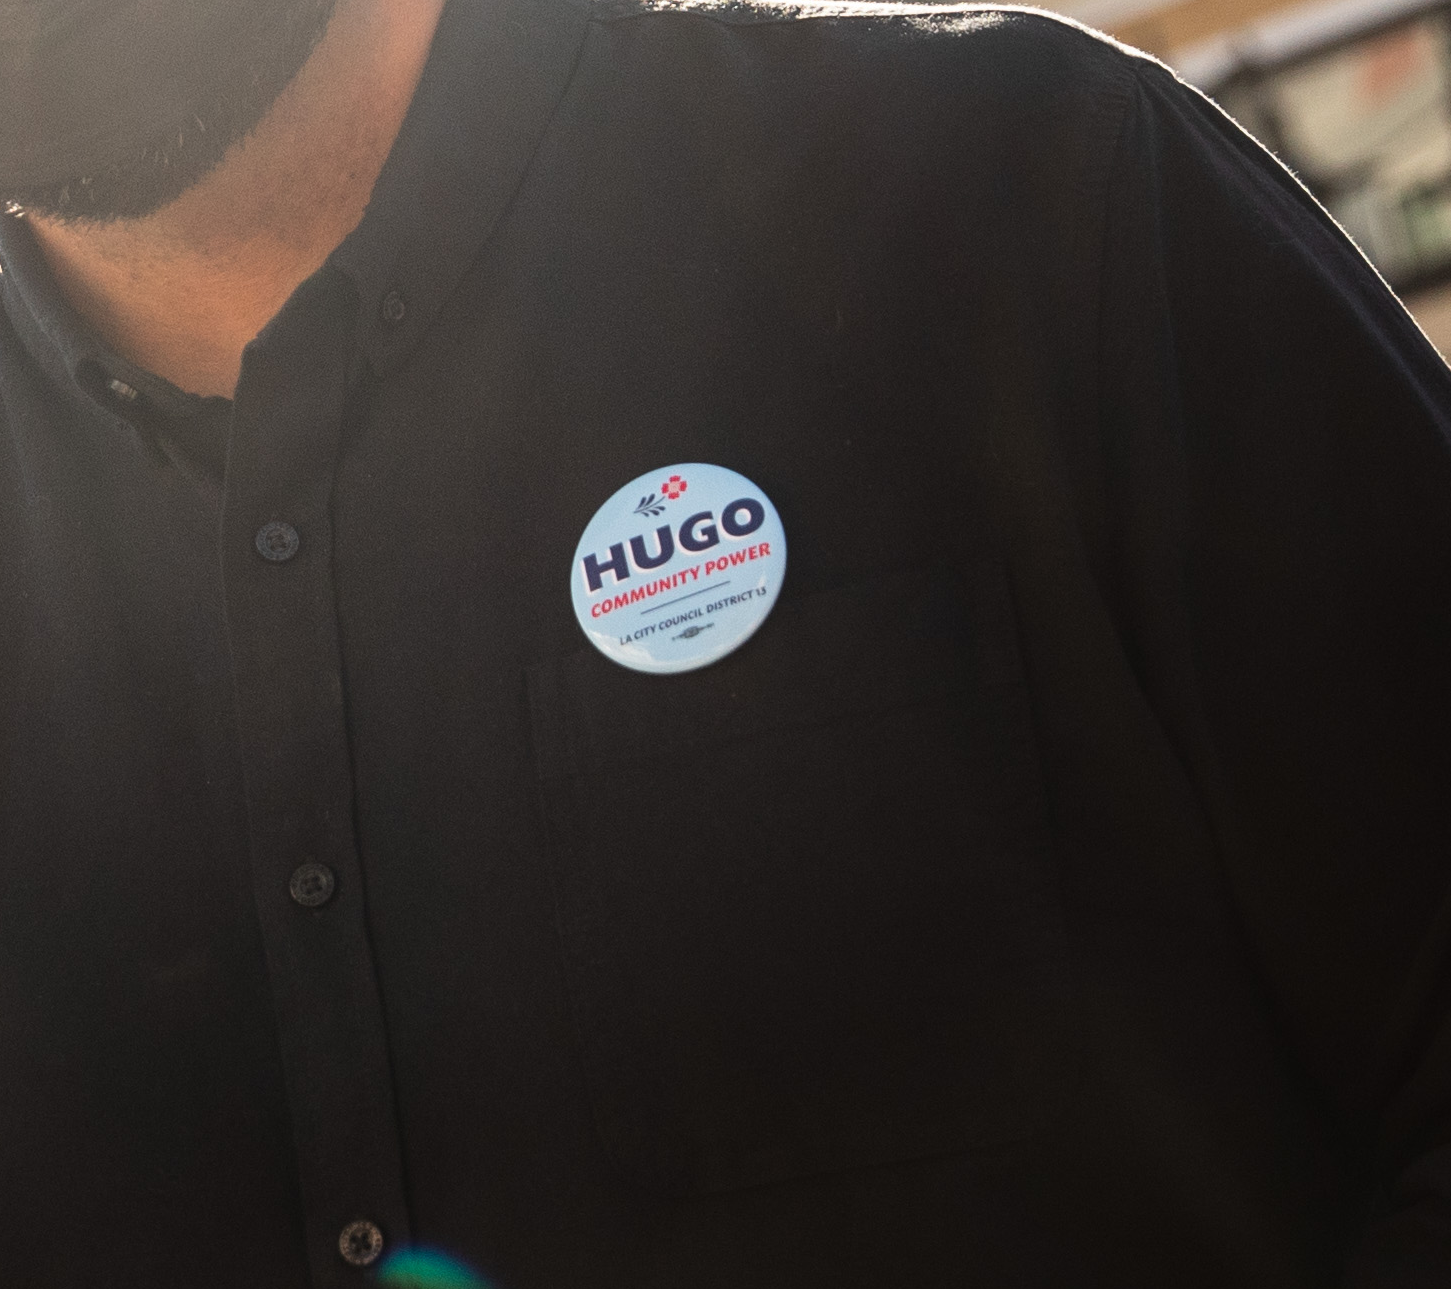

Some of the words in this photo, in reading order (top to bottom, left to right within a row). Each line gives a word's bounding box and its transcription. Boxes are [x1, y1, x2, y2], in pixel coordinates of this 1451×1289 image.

[582, 497, 766, 592] HUGO
[590, 565, 701, 618] COMMUNITY
[705, 542, 771, 576] POWER
[620, 634, 633, 646] LA
[634, 624, 657, 640] CITY
[658, 607, 705, 631] COUNCIL
[706, 589, 754, 614] DISTRICT
